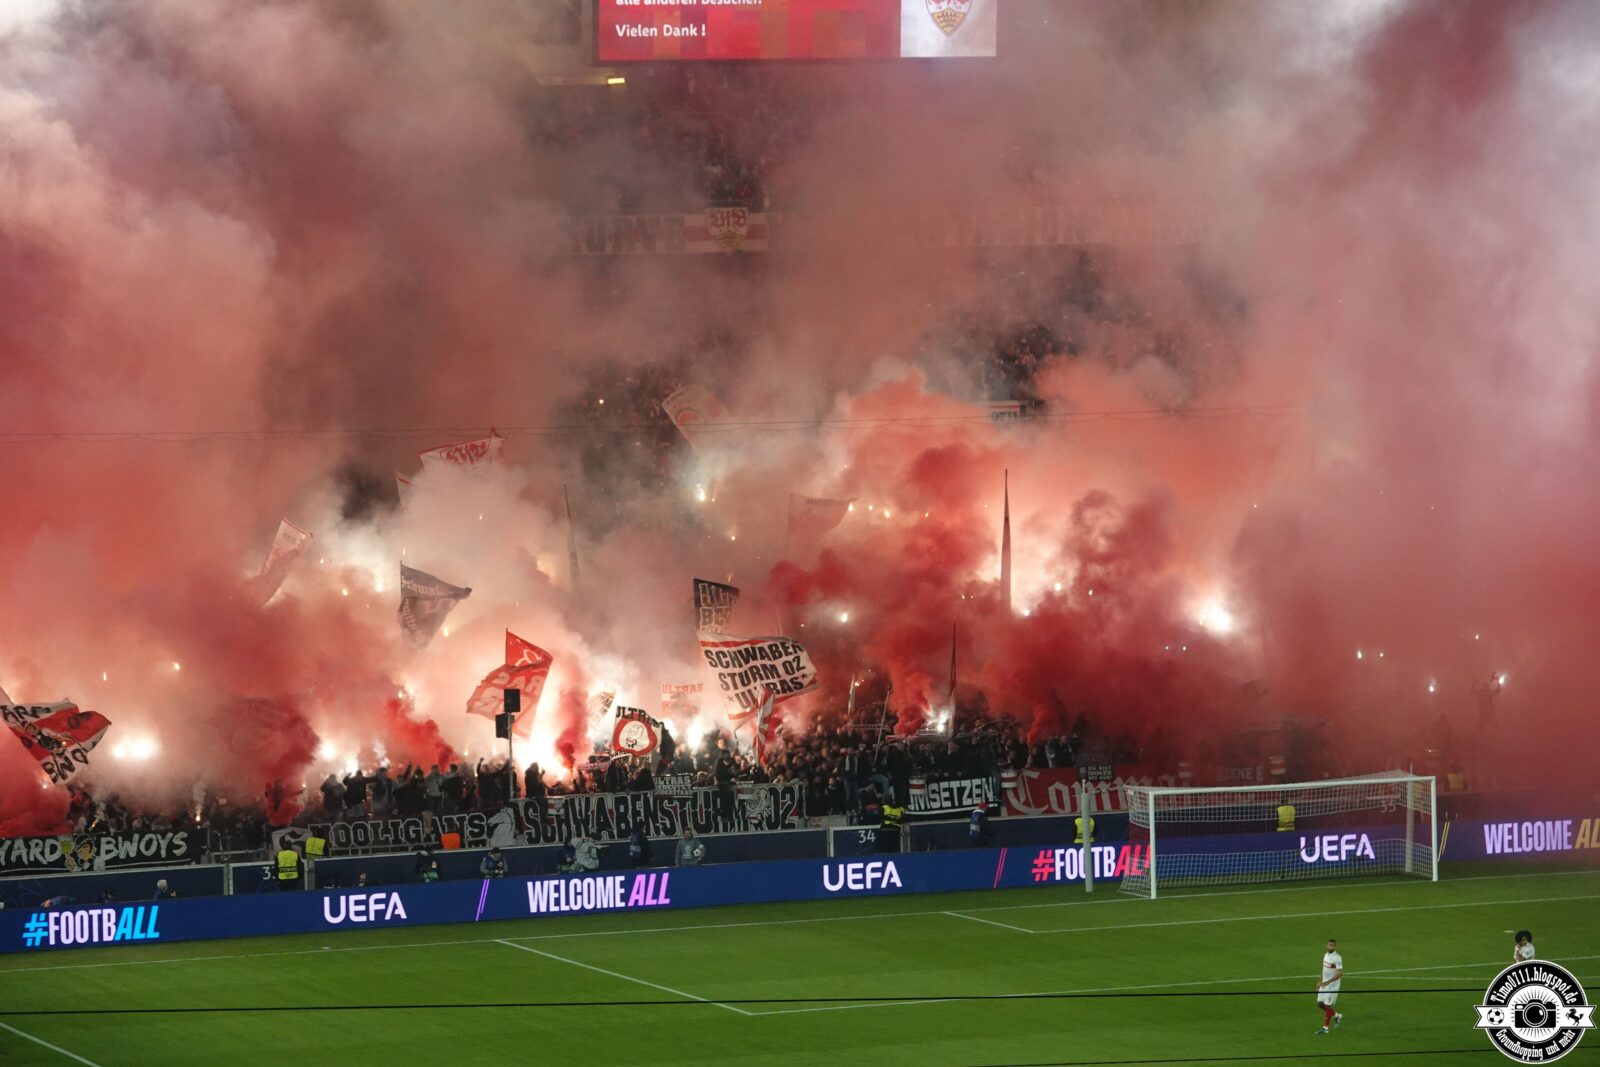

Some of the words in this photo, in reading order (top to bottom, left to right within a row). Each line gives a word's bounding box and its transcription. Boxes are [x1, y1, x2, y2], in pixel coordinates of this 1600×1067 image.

[616, 24, 658, 37] Vielen
[663, 24, 698, 37] Dank
[701, 24, 706, 37] !
[704, 641, 805, 668] SCHWABEN
[718, 663, 782, 691] STURM
[784, 655, 807, 675] 02
[734, 676, 805, 710] ULRAS
[100, 831, 188, 861] BWOYS
[857, 829, 877, 844] 34
[1299, 833, 1375, 863] UEFA
[1484, 819, 1573, 854] WELCOME
[822, 861, 902, 891] UEFA
[323, 892, 407, 924] UEFA
[527, 875, 626, 913] WELCOME
[628, 872, 671, 907] ALL
[22, 905, 160, 946] #FOOTBALL
